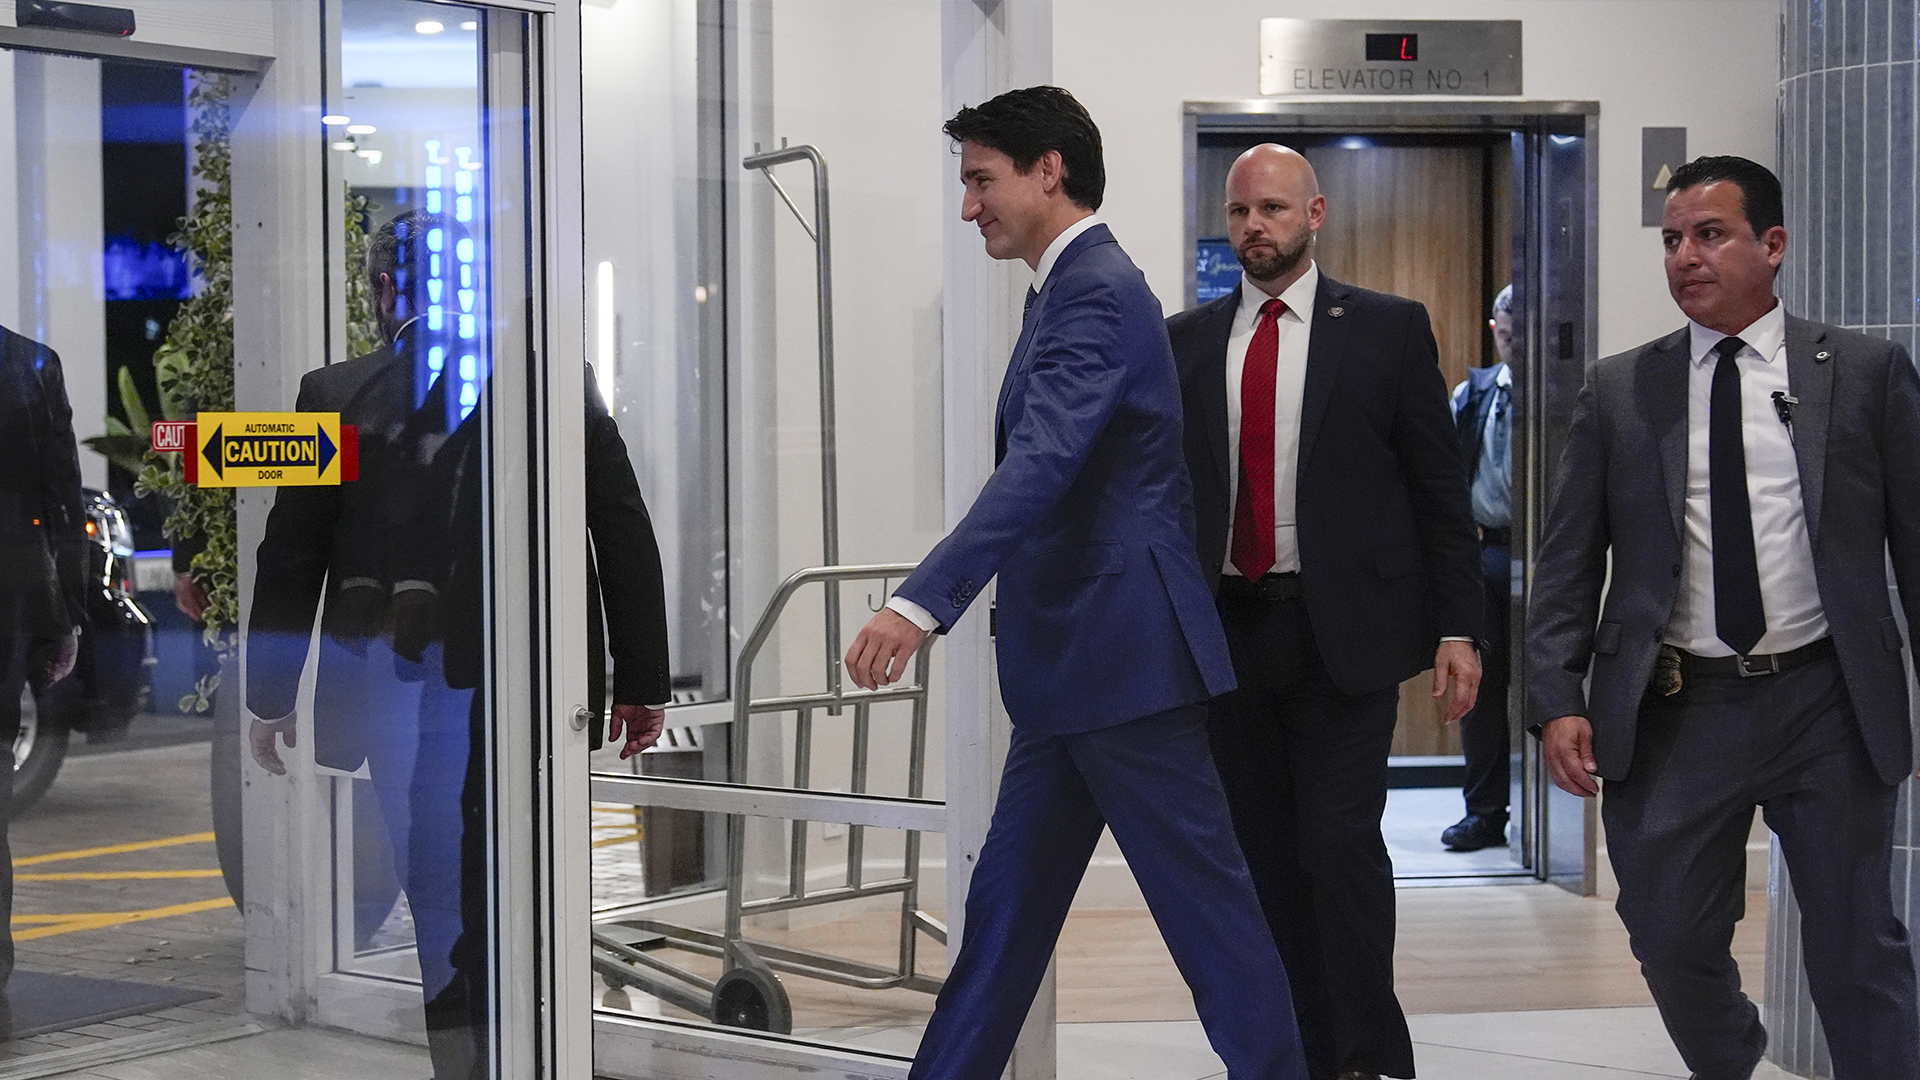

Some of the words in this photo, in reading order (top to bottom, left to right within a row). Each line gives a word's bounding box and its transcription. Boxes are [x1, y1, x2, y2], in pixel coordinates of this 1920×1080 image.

[1400, 37, 1413, 60] L
[1293, 68, 1414, 90] ELEVATOR
[1482, 68, 1490, 90] 1
[245, 423, 295, 433] AUTOMATIC
[225, 440, 315, 463] CAUTION
[258, 470, 283, 480] DOOR
